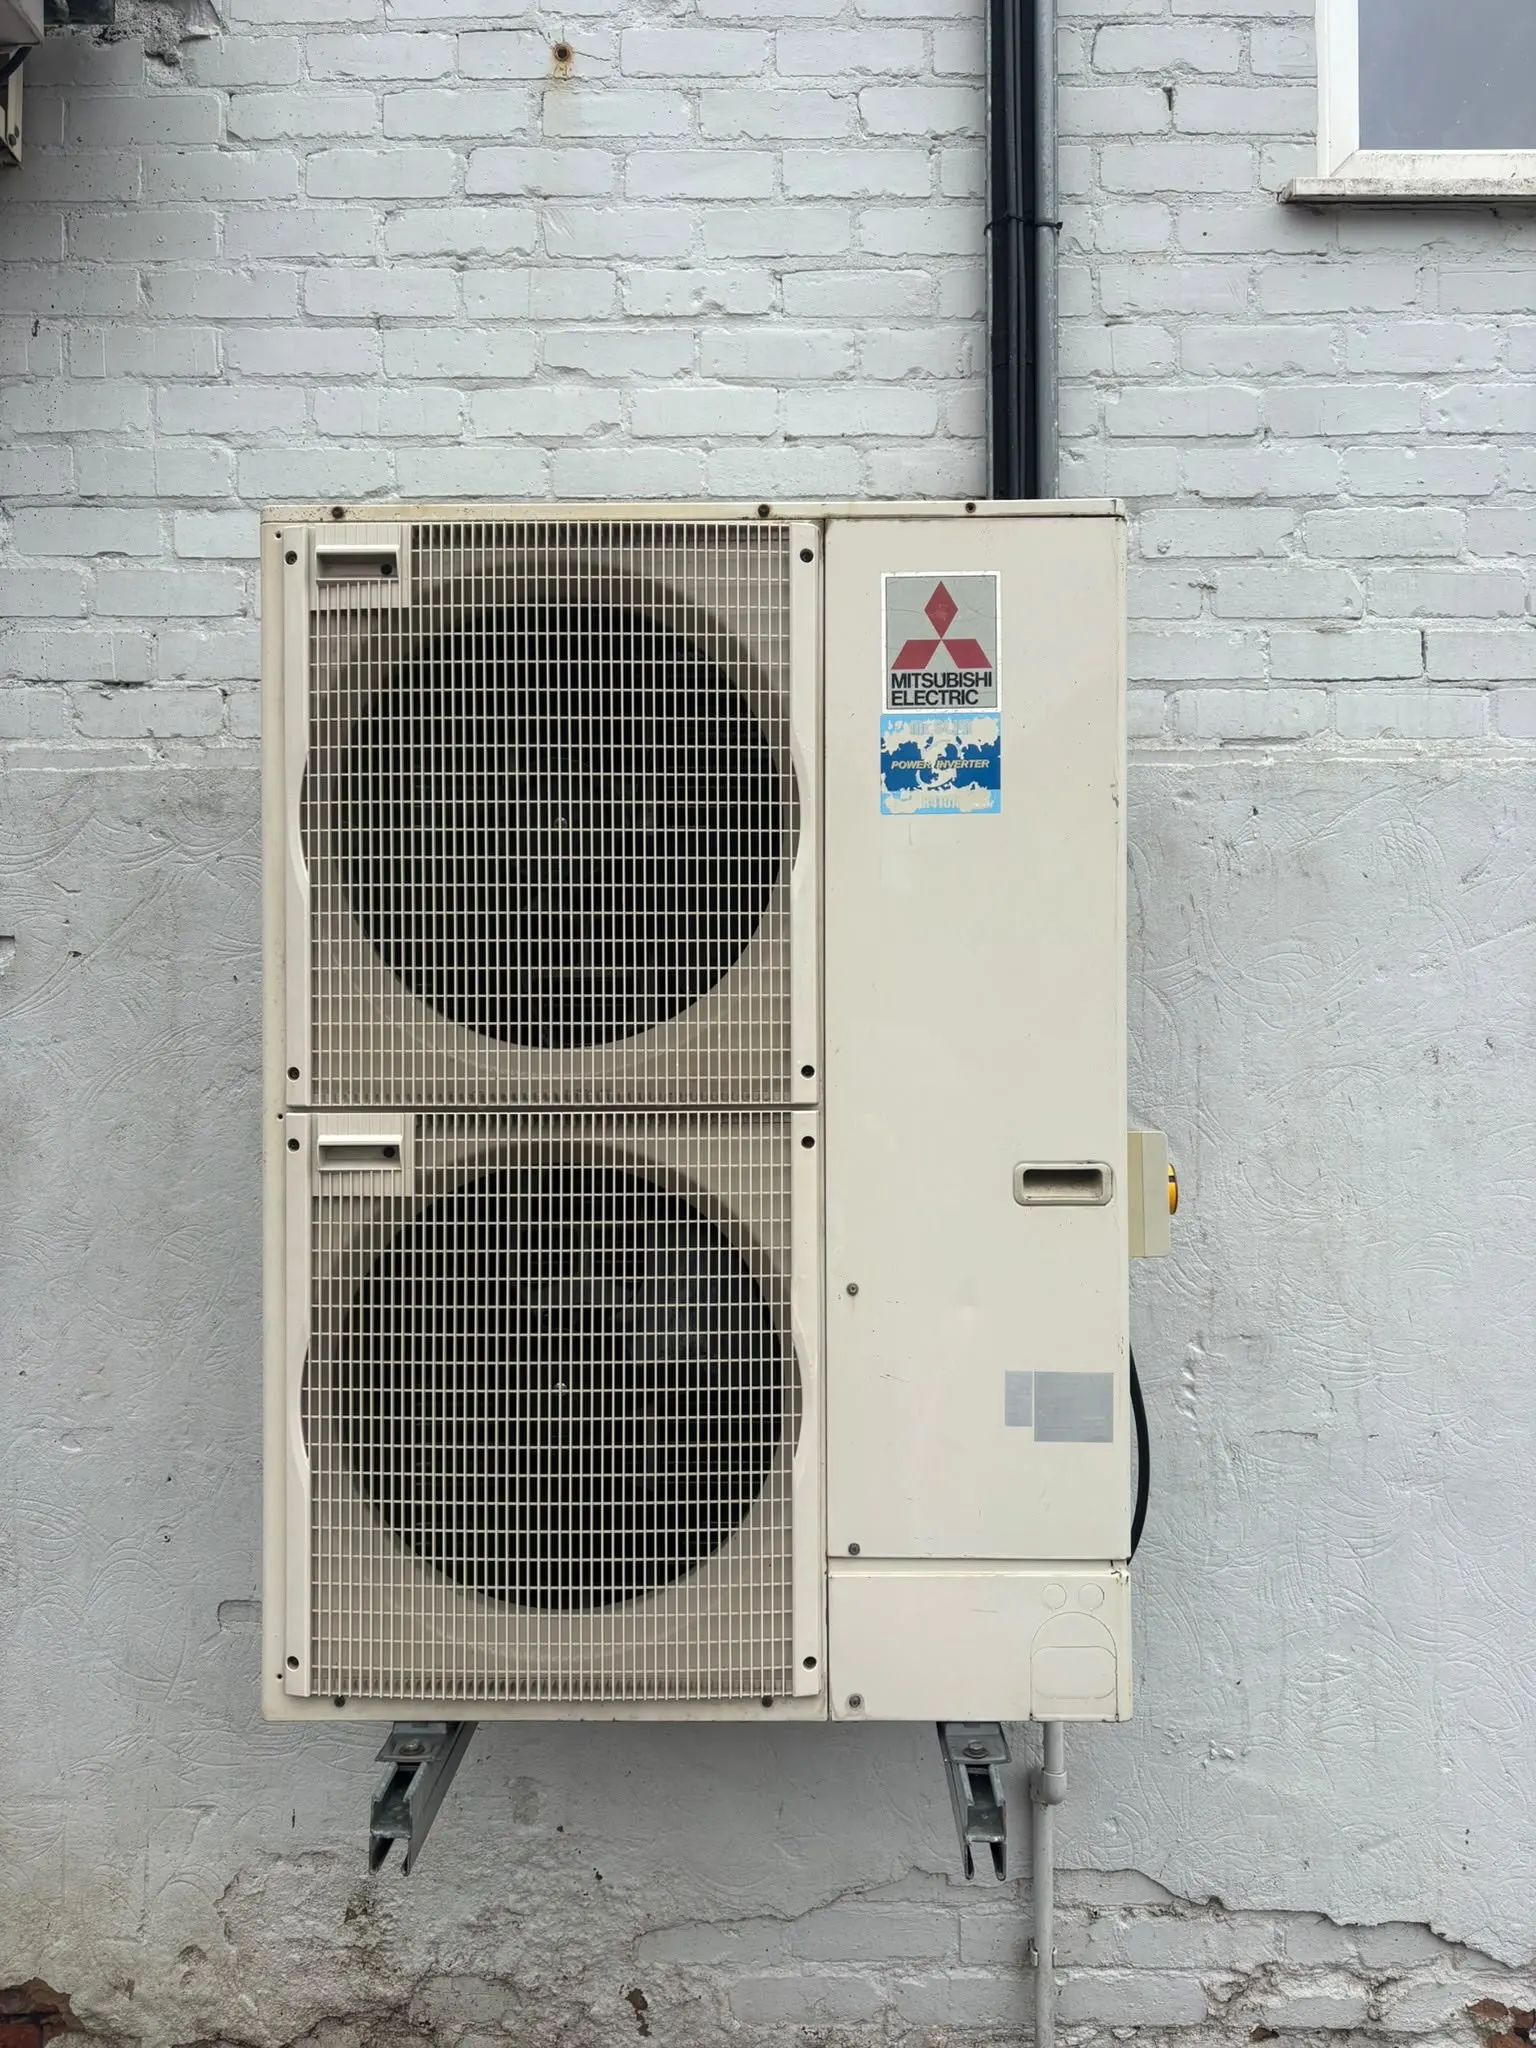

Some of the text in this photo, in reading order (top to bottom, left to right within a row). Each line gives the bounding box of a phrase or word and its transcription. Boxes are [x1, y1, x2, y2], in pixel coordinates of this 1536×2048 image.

[891, 671, 992, 689] MITSUBISHI
[891, 689, 979, 706] ELECTRIC
[891, 759, 990, 770] POWER INVERTER
